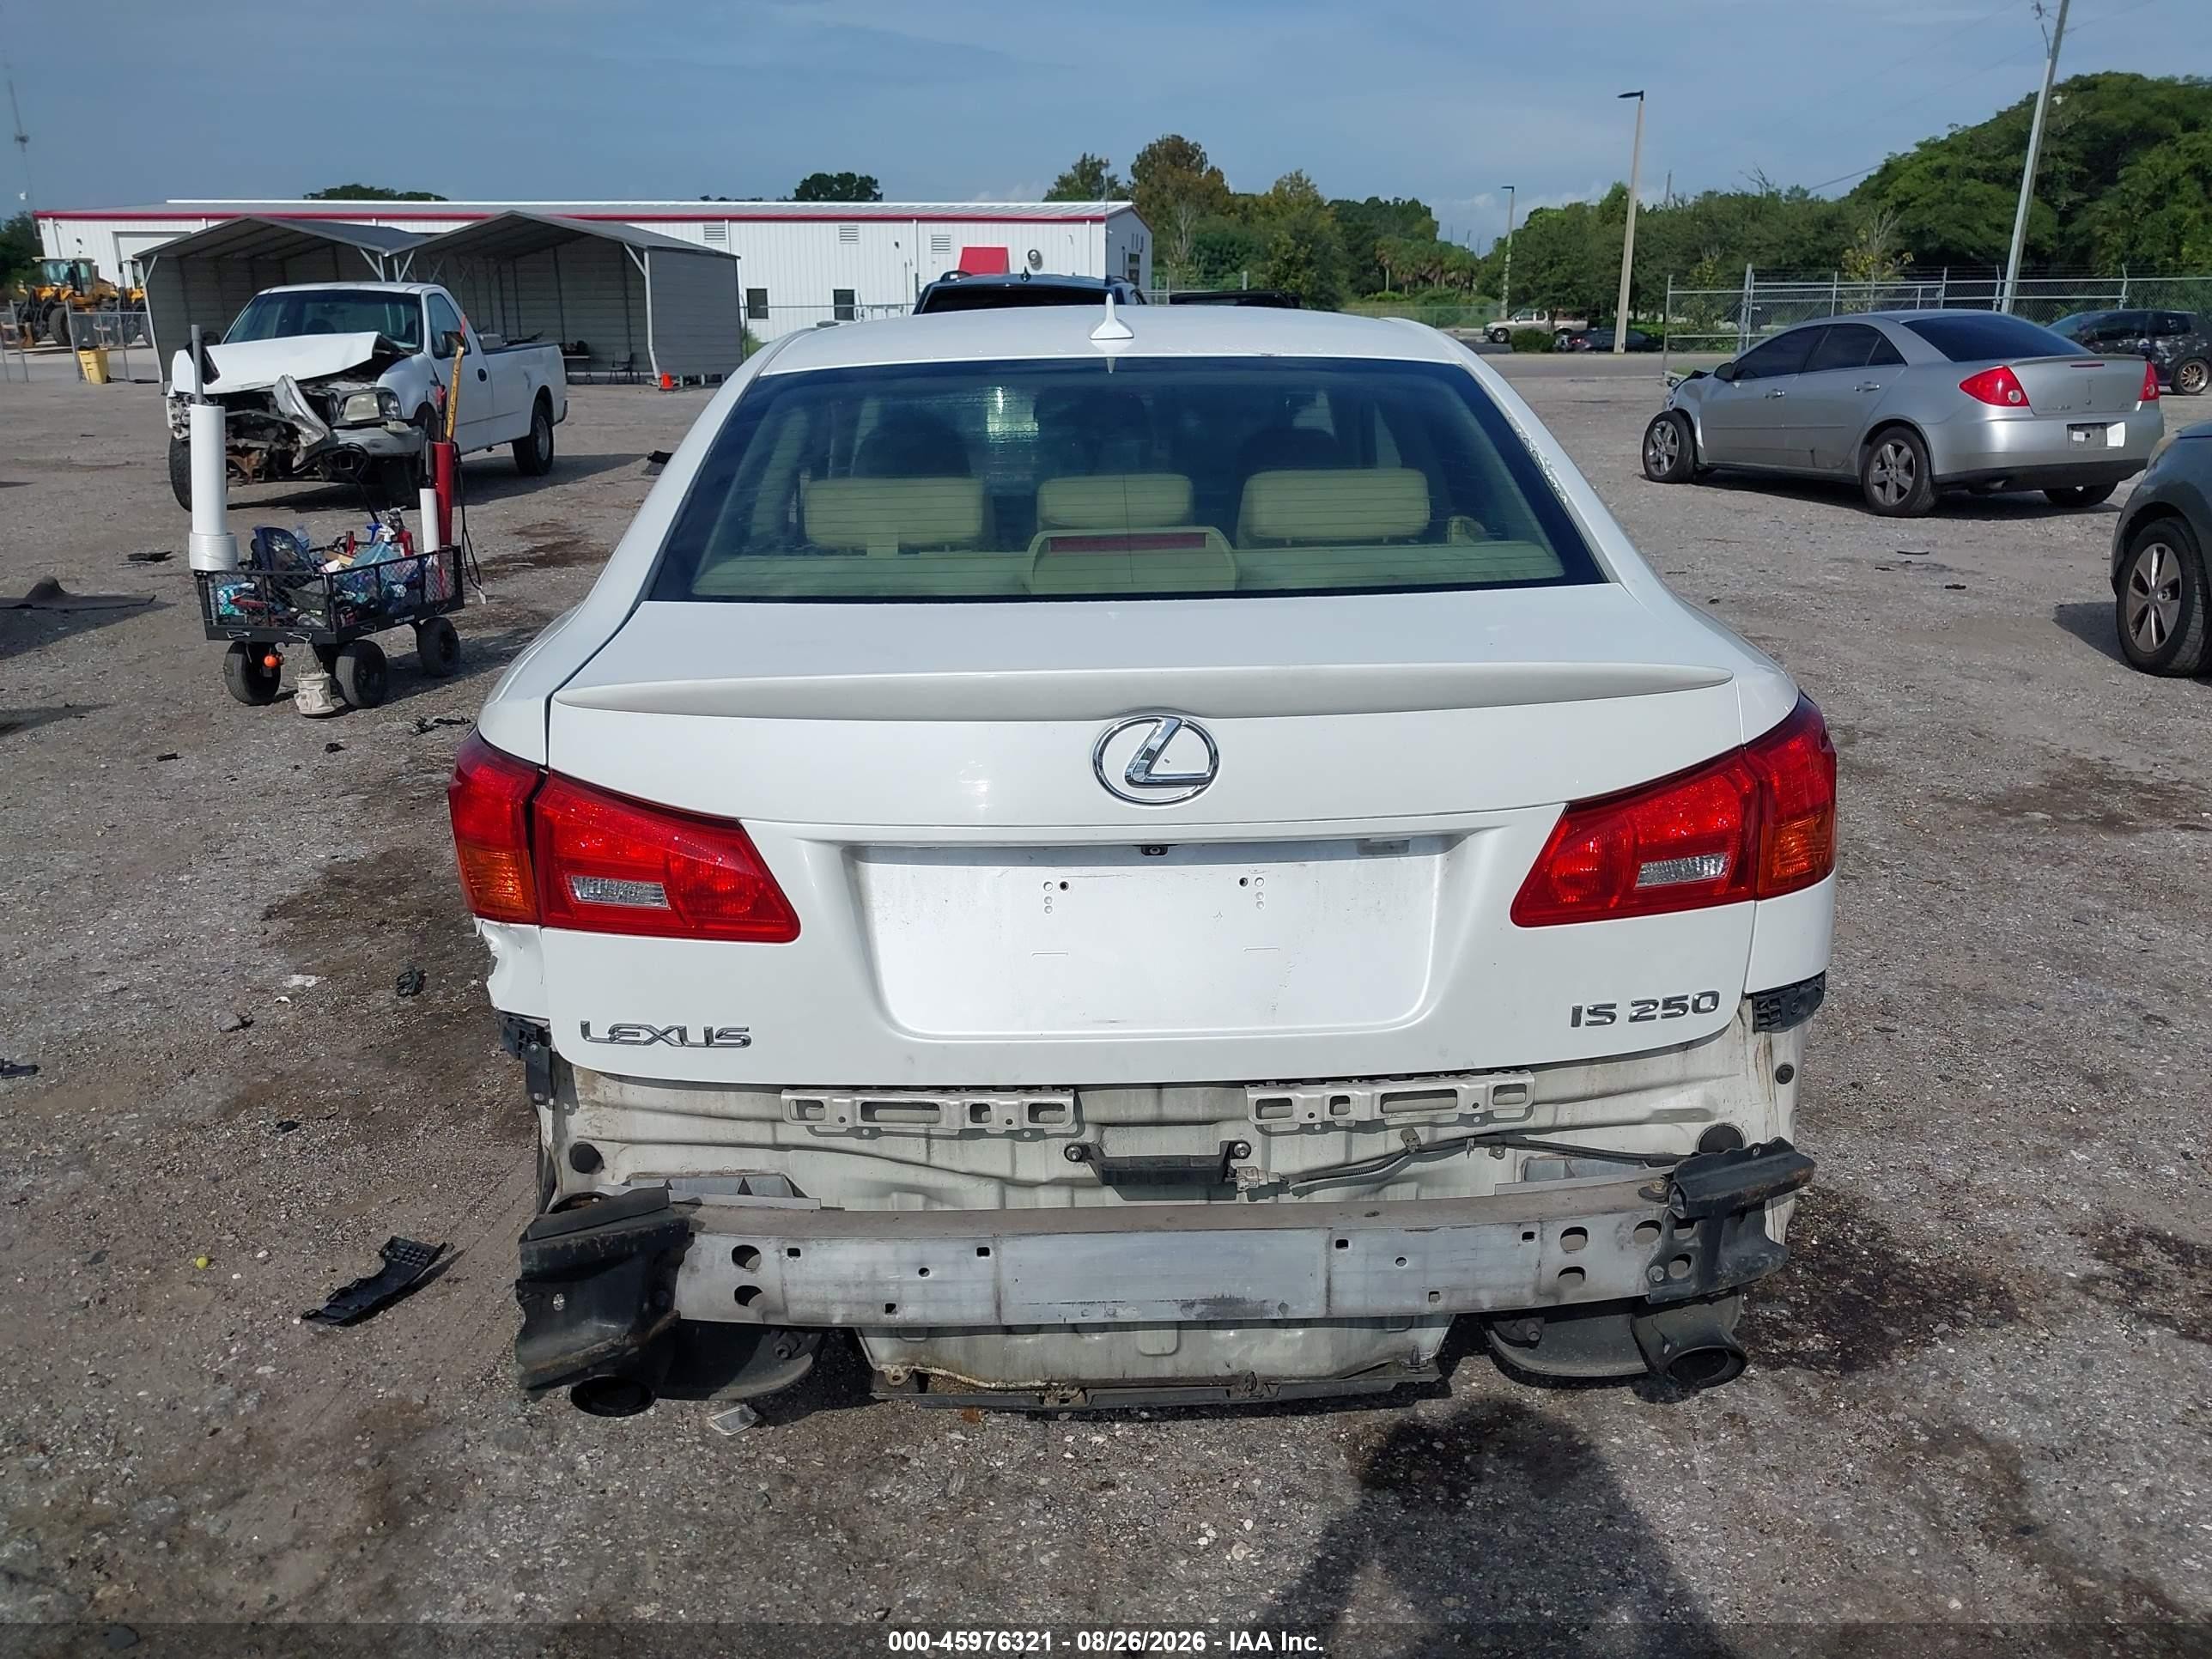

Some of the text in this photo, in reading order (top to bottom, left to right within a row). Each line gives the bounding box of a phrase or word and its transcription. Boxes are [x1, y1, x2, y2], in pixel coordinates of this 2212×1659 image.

[1571, 990, 1720, 1028] IS 250
[580, 1019, 752, 1048] LEXUS
